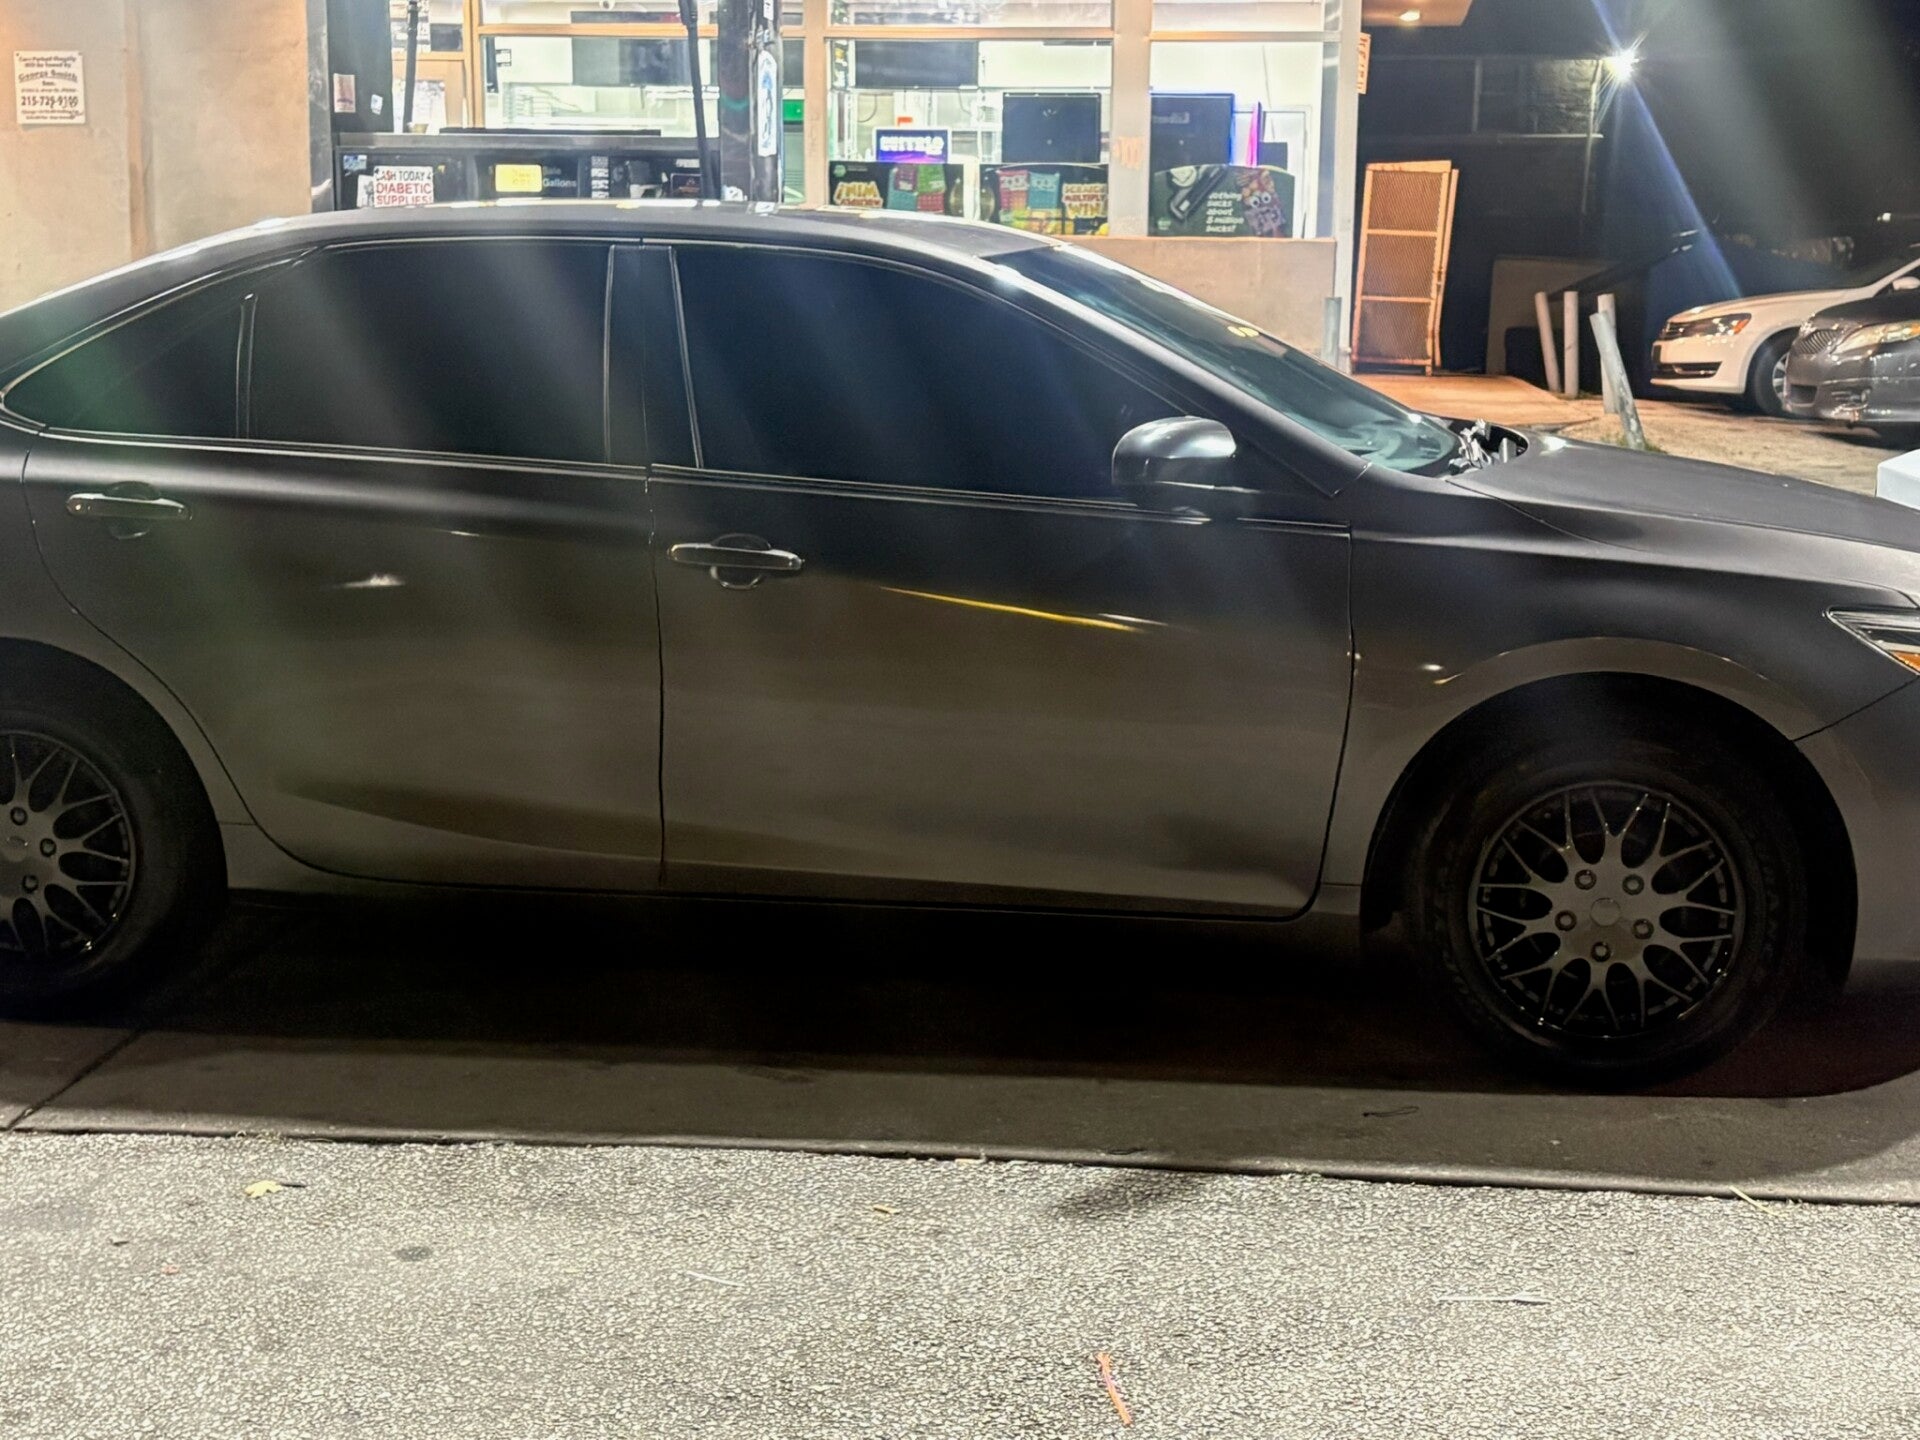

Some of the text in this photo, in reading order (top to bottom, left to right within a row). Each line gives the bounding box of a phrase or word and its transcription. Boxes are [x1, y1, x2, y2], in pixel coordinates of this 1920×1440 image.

[399, 171, 425, 182] TODAY
[376, 183, 432, 194] DIABETIC
[543, 179, 577, 188] Gallons
